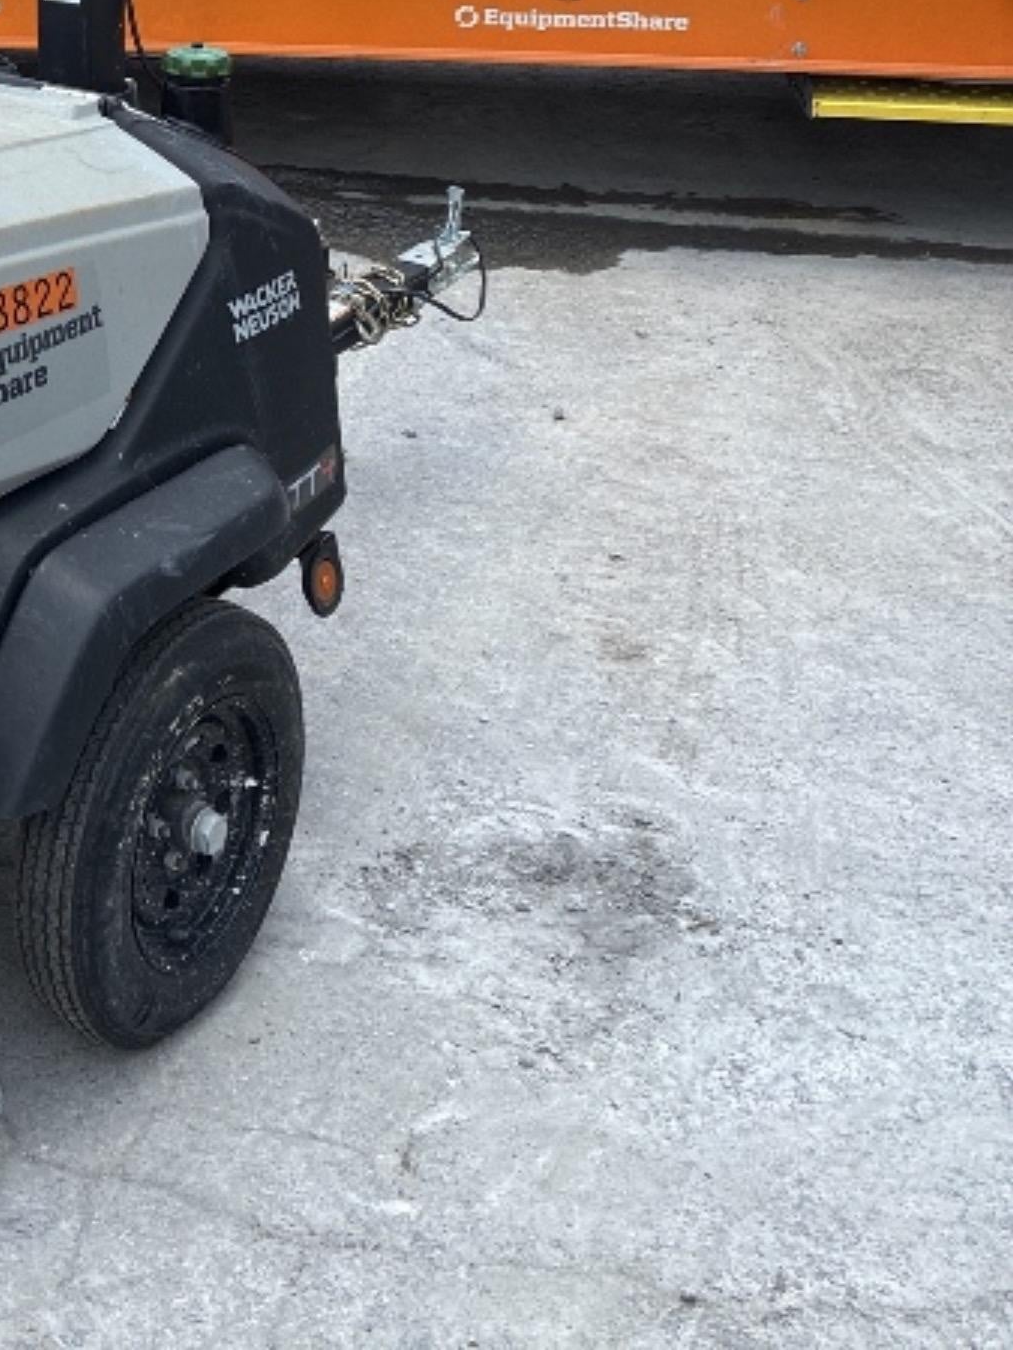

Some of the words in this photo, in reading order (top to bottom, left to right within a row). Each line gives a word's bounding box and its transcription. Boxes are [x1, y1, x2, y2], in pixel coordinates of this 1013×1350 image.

[484, 7, 689, 31] EquipmentShare
[227, 269, 298, 319] WACKER
[233, 291, 301, 344] NEUSON
